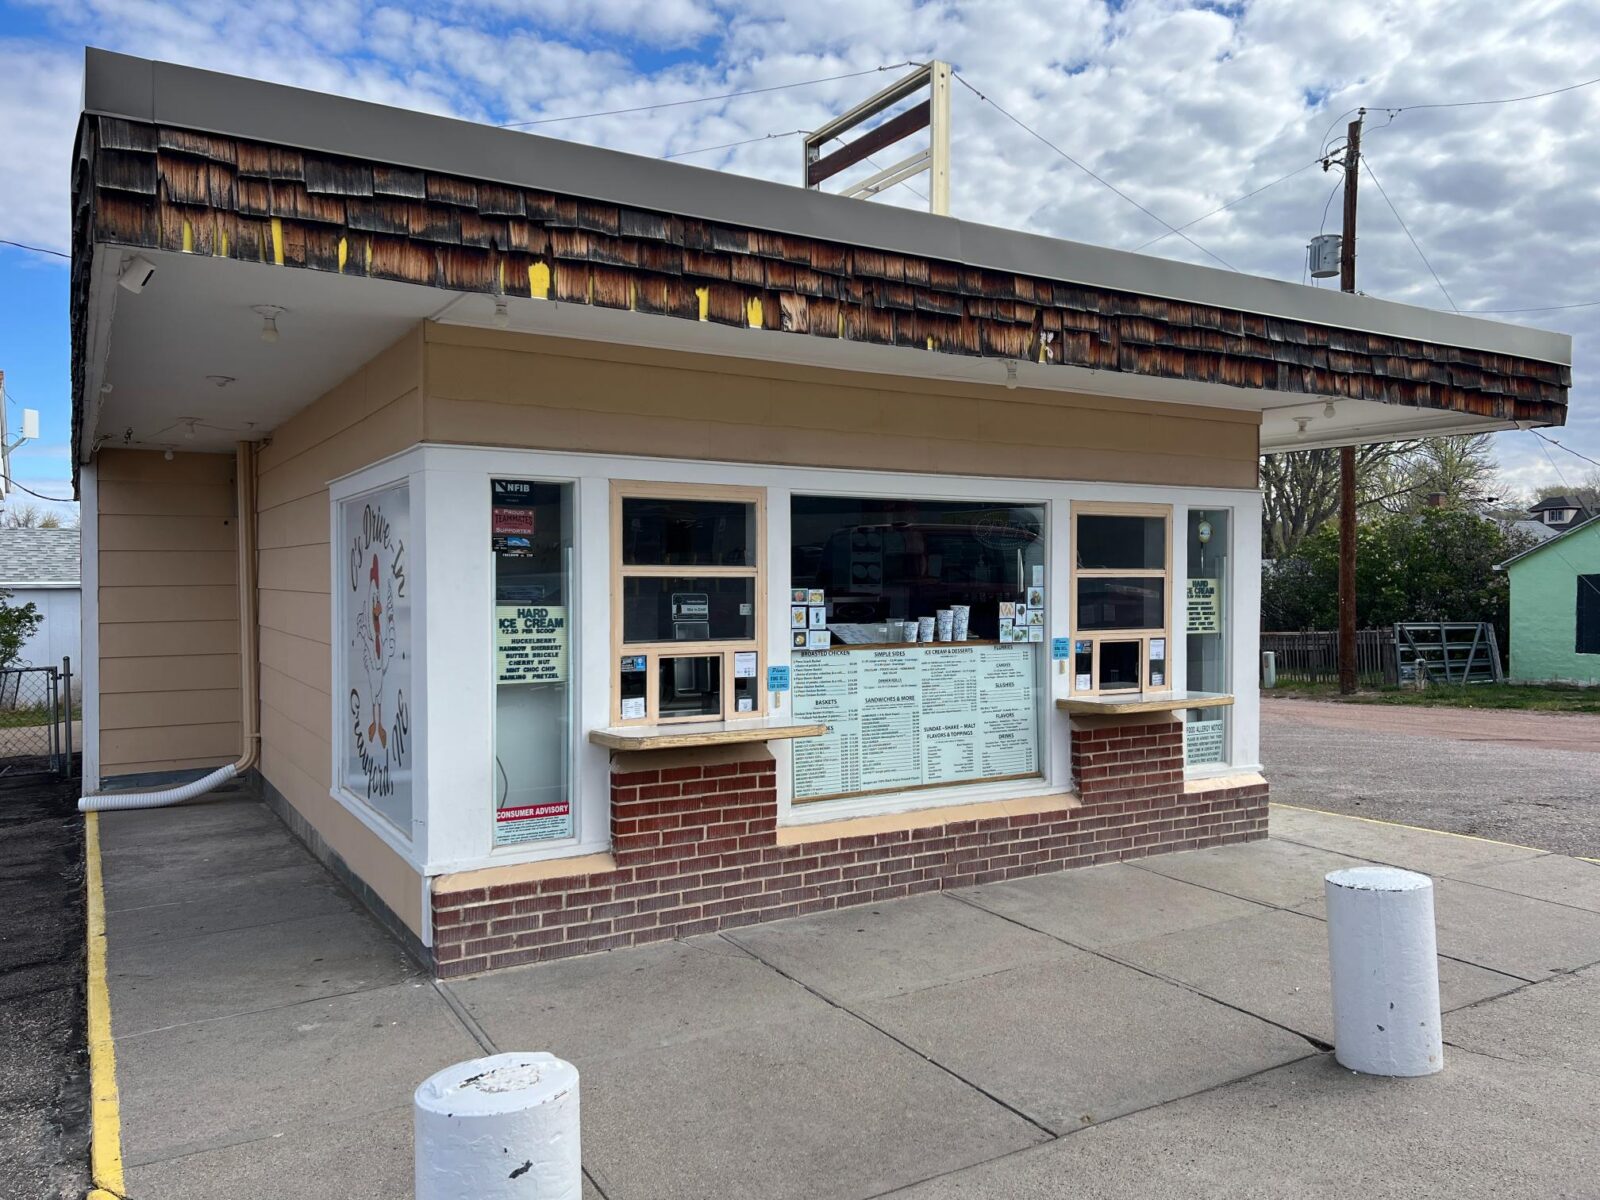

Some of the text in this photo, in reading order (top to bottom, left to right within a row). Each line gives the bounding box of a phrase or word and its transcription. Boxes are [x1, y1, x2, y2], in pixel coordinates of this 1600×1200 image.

[507, 483, 530, 492] NFIB
[517, 608, 549, 619] HARD
[499, 618, 564, 629] ICE CREAM
[865, 696, 896, 704] SANDWICHES
[496, 805, 568, 819] CONSUMER ADVISORY
